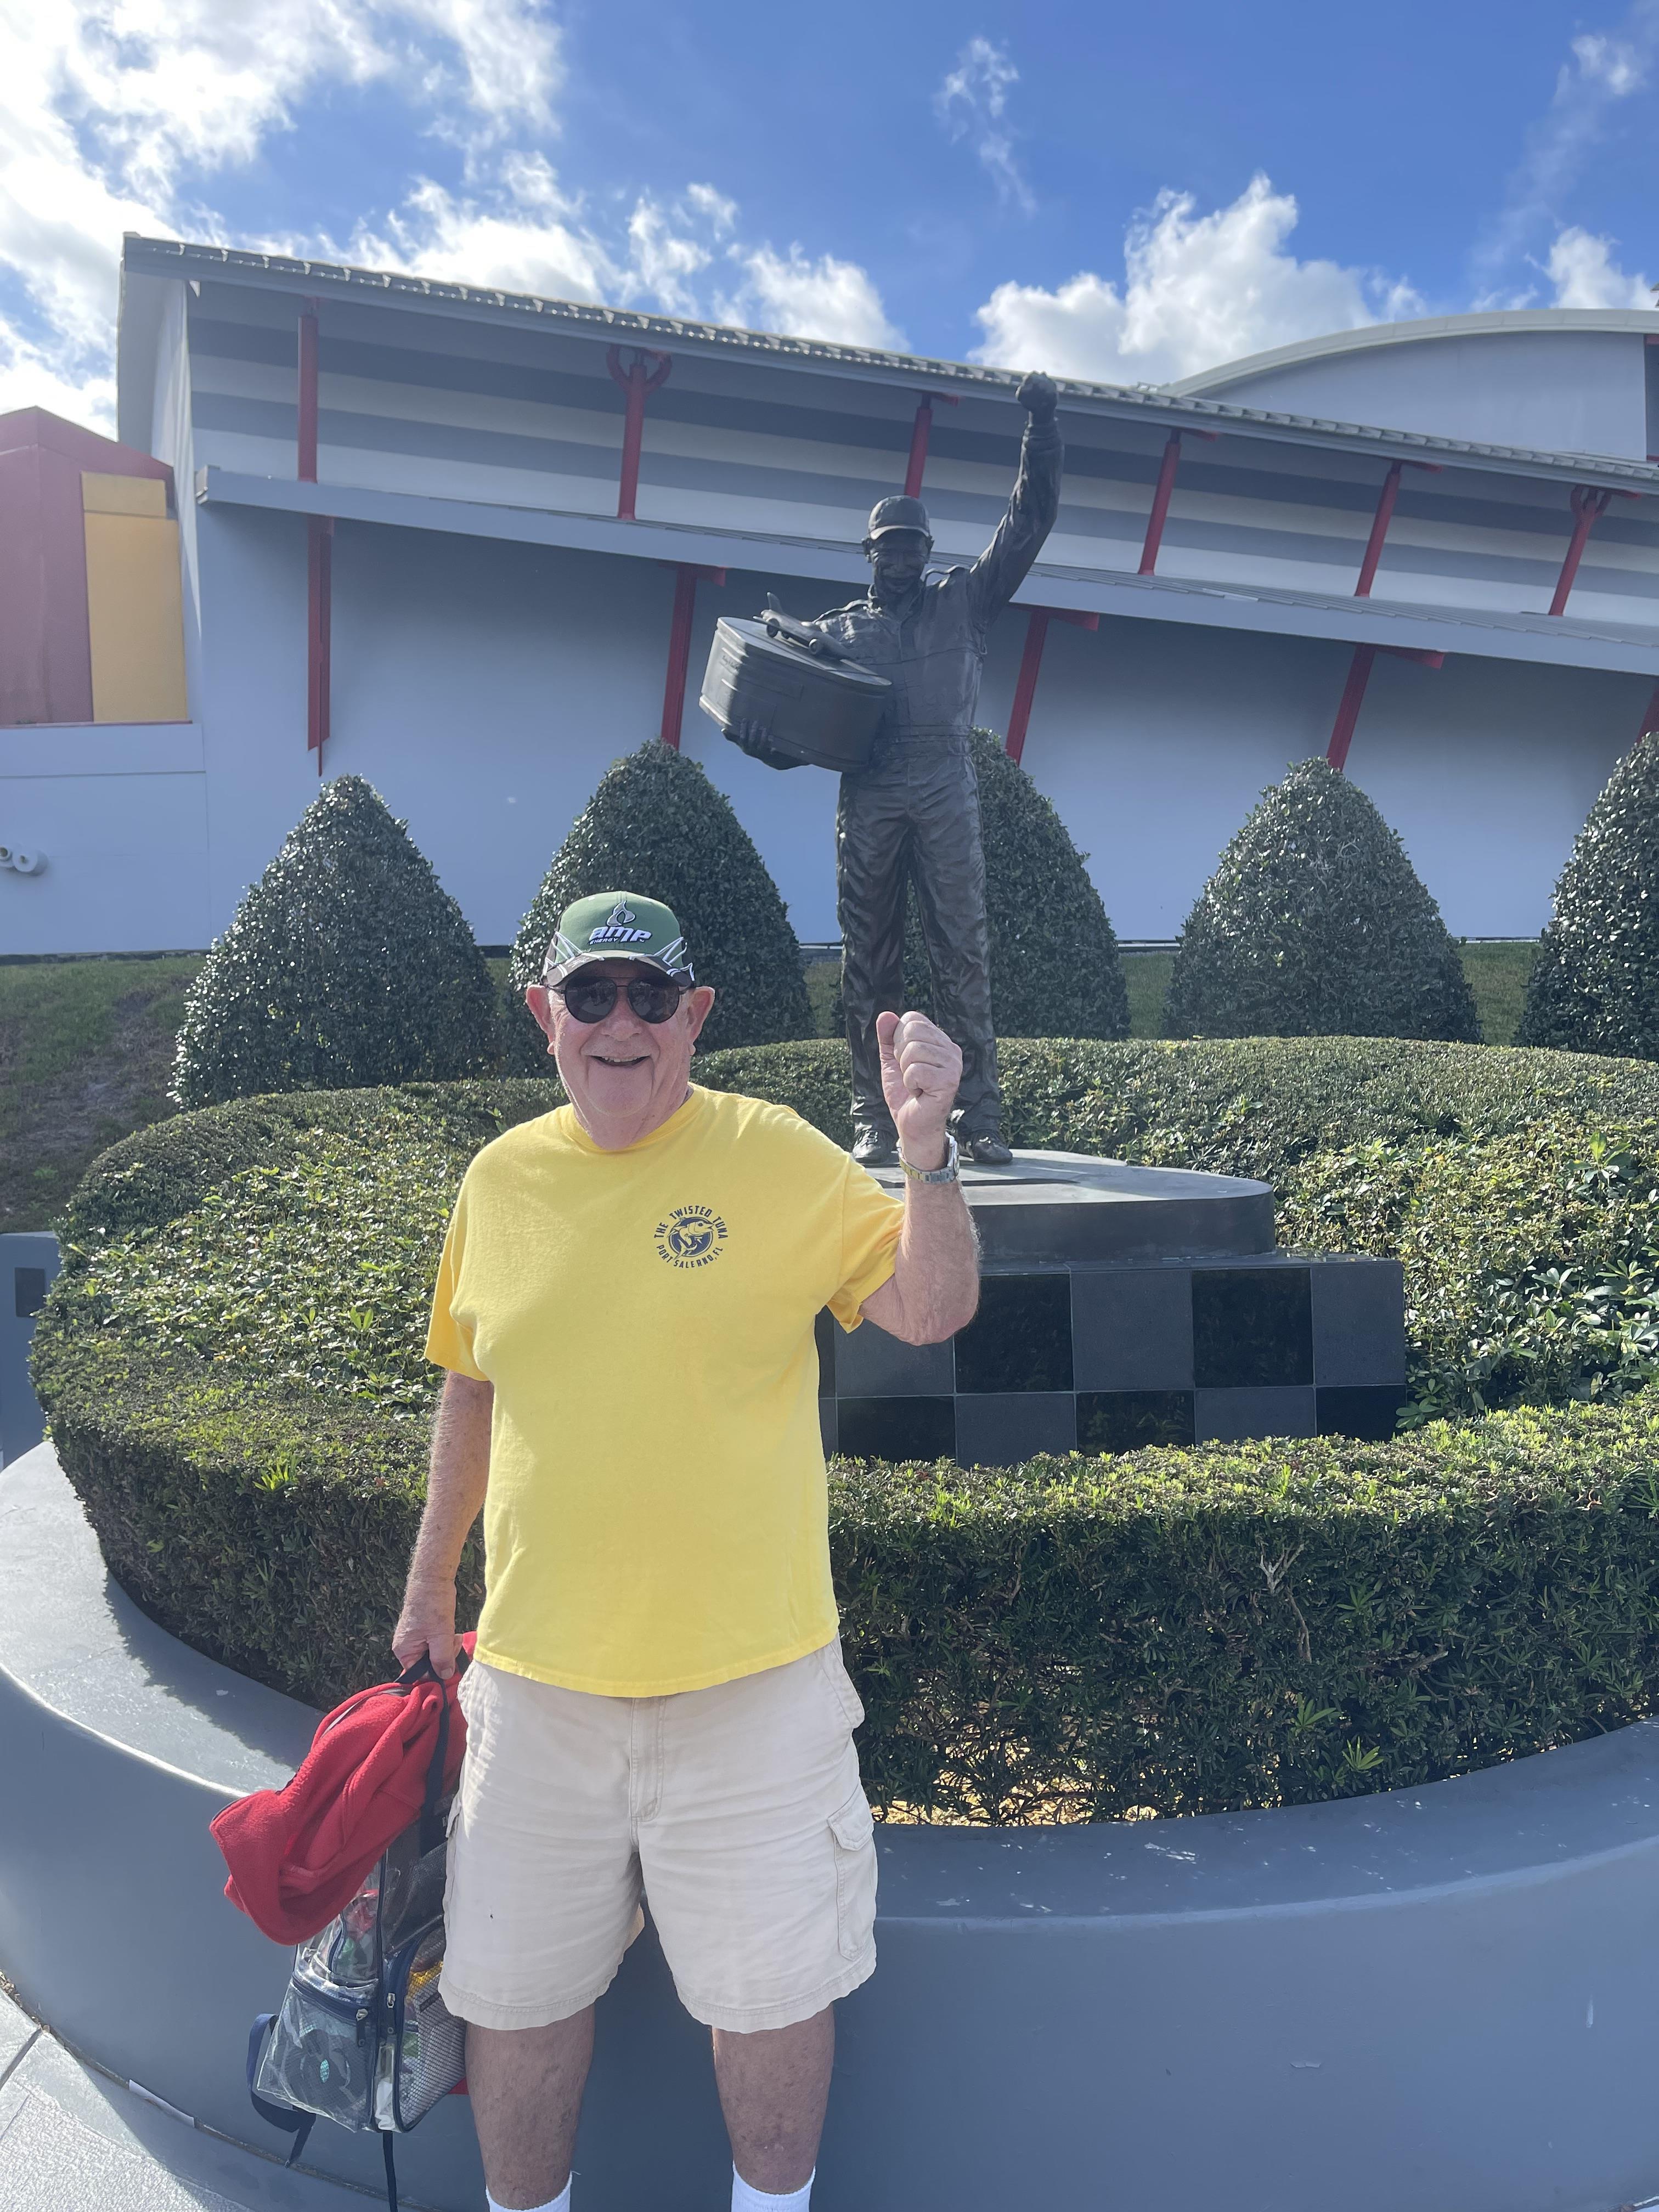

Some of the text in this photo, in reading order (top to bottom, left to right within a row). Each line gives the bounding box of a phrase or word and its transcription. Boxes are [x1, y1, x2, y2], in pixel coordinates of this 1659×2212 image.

[654, 1205, 729, 1239] THE TWISTED TUNA
[656, 1244, 674, 1263] PORT
